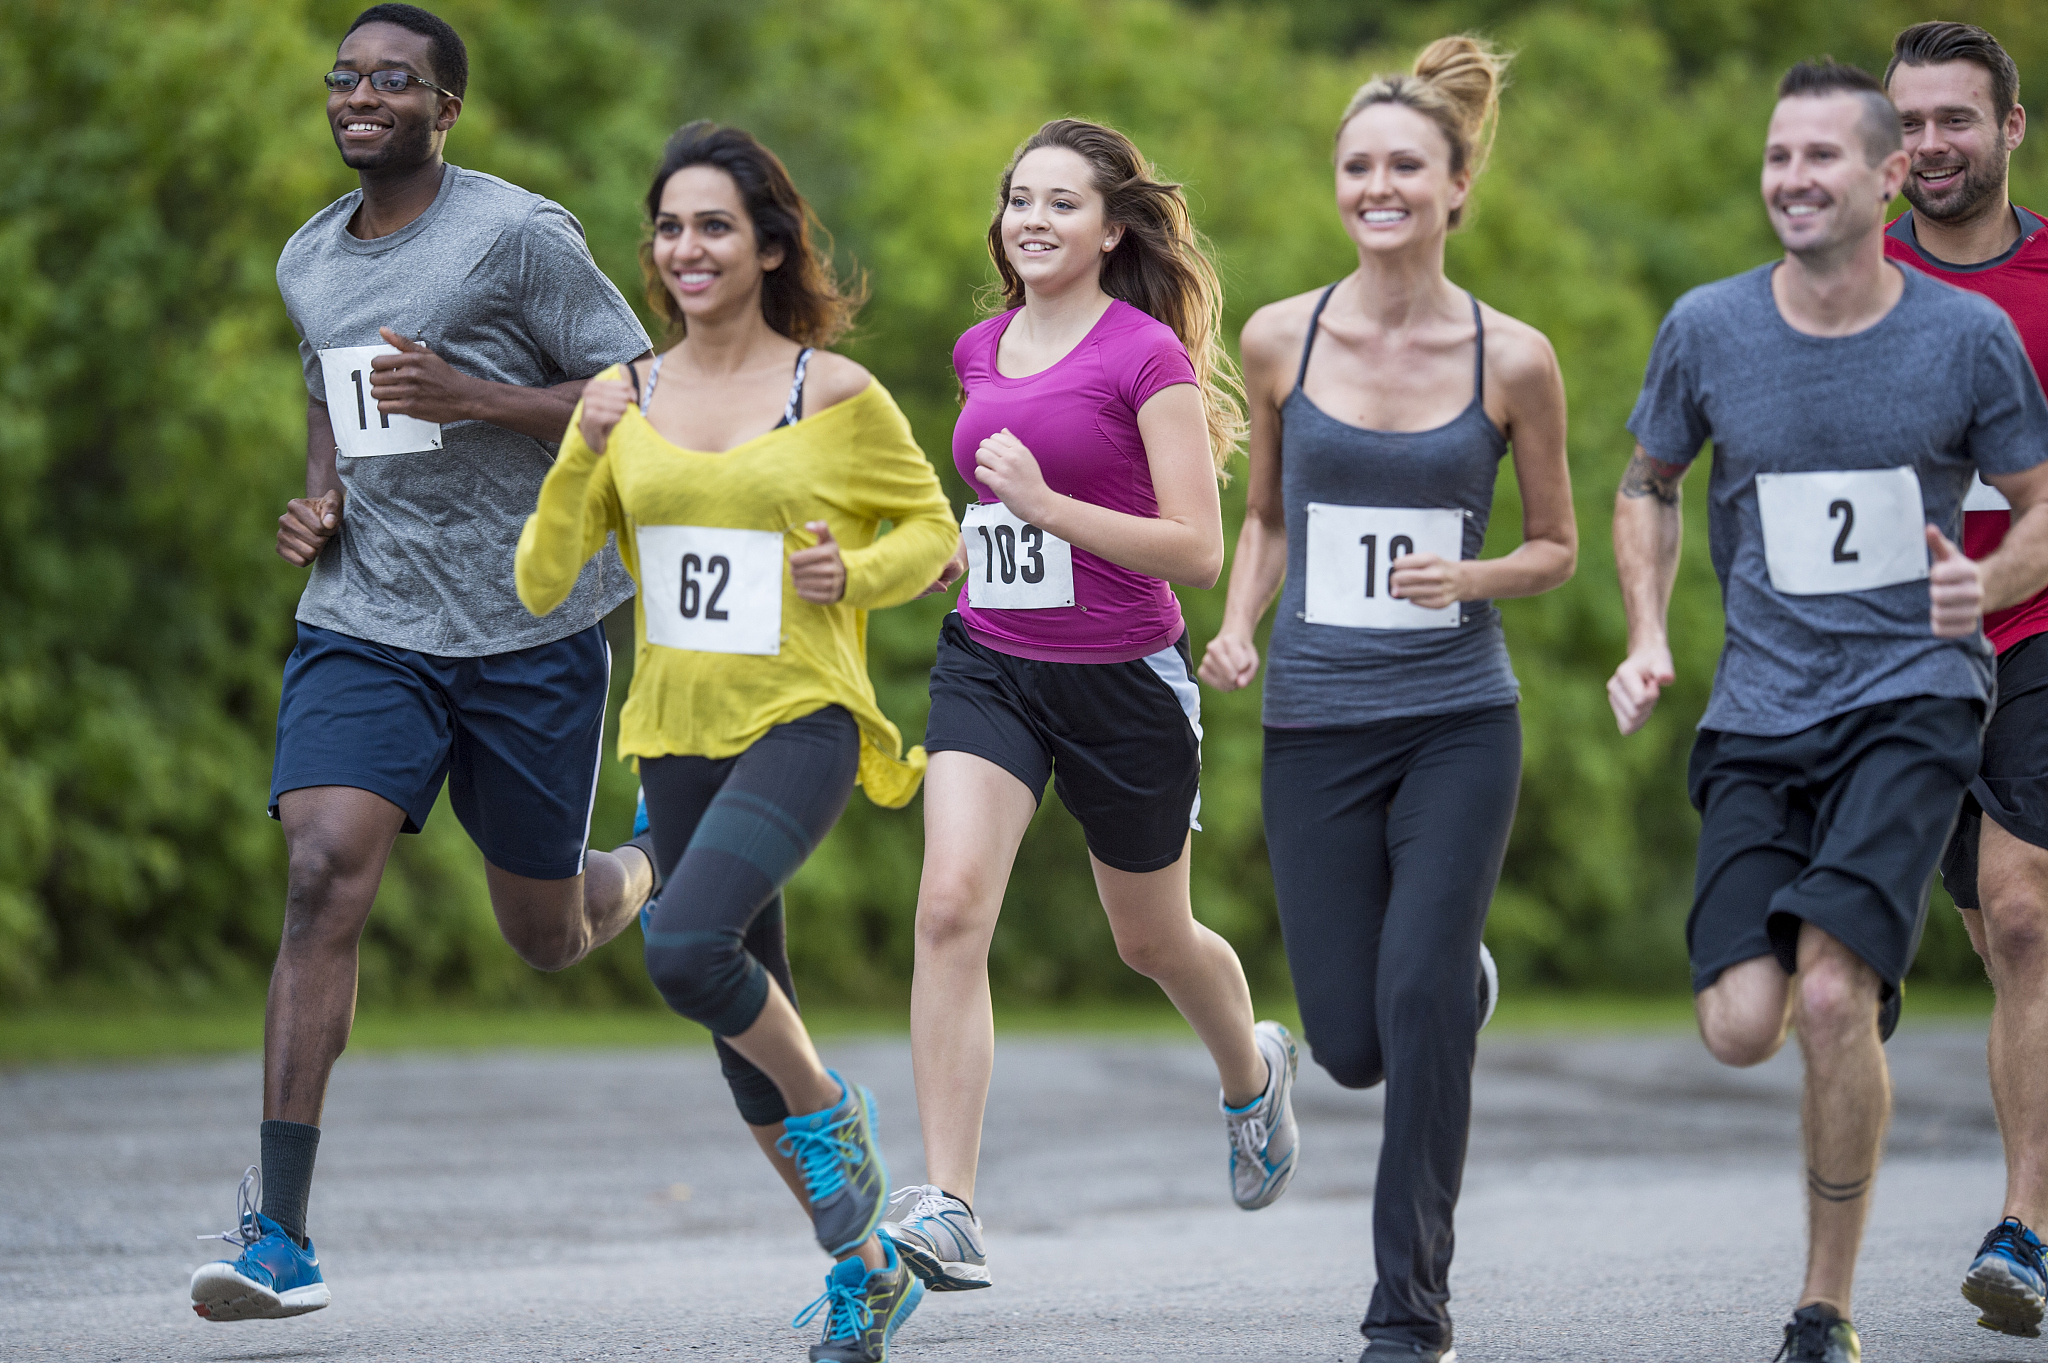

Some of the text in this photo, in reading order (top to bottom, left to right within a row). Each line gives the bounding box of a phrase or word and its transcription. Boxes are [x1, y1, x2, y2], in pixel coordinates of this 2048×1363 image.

[350, 369, 390, 430] 1
[977, 523, 1045, 585] 103
[1828, 498, 1860, 564] 2
[679, 552, 730, 621] 62
